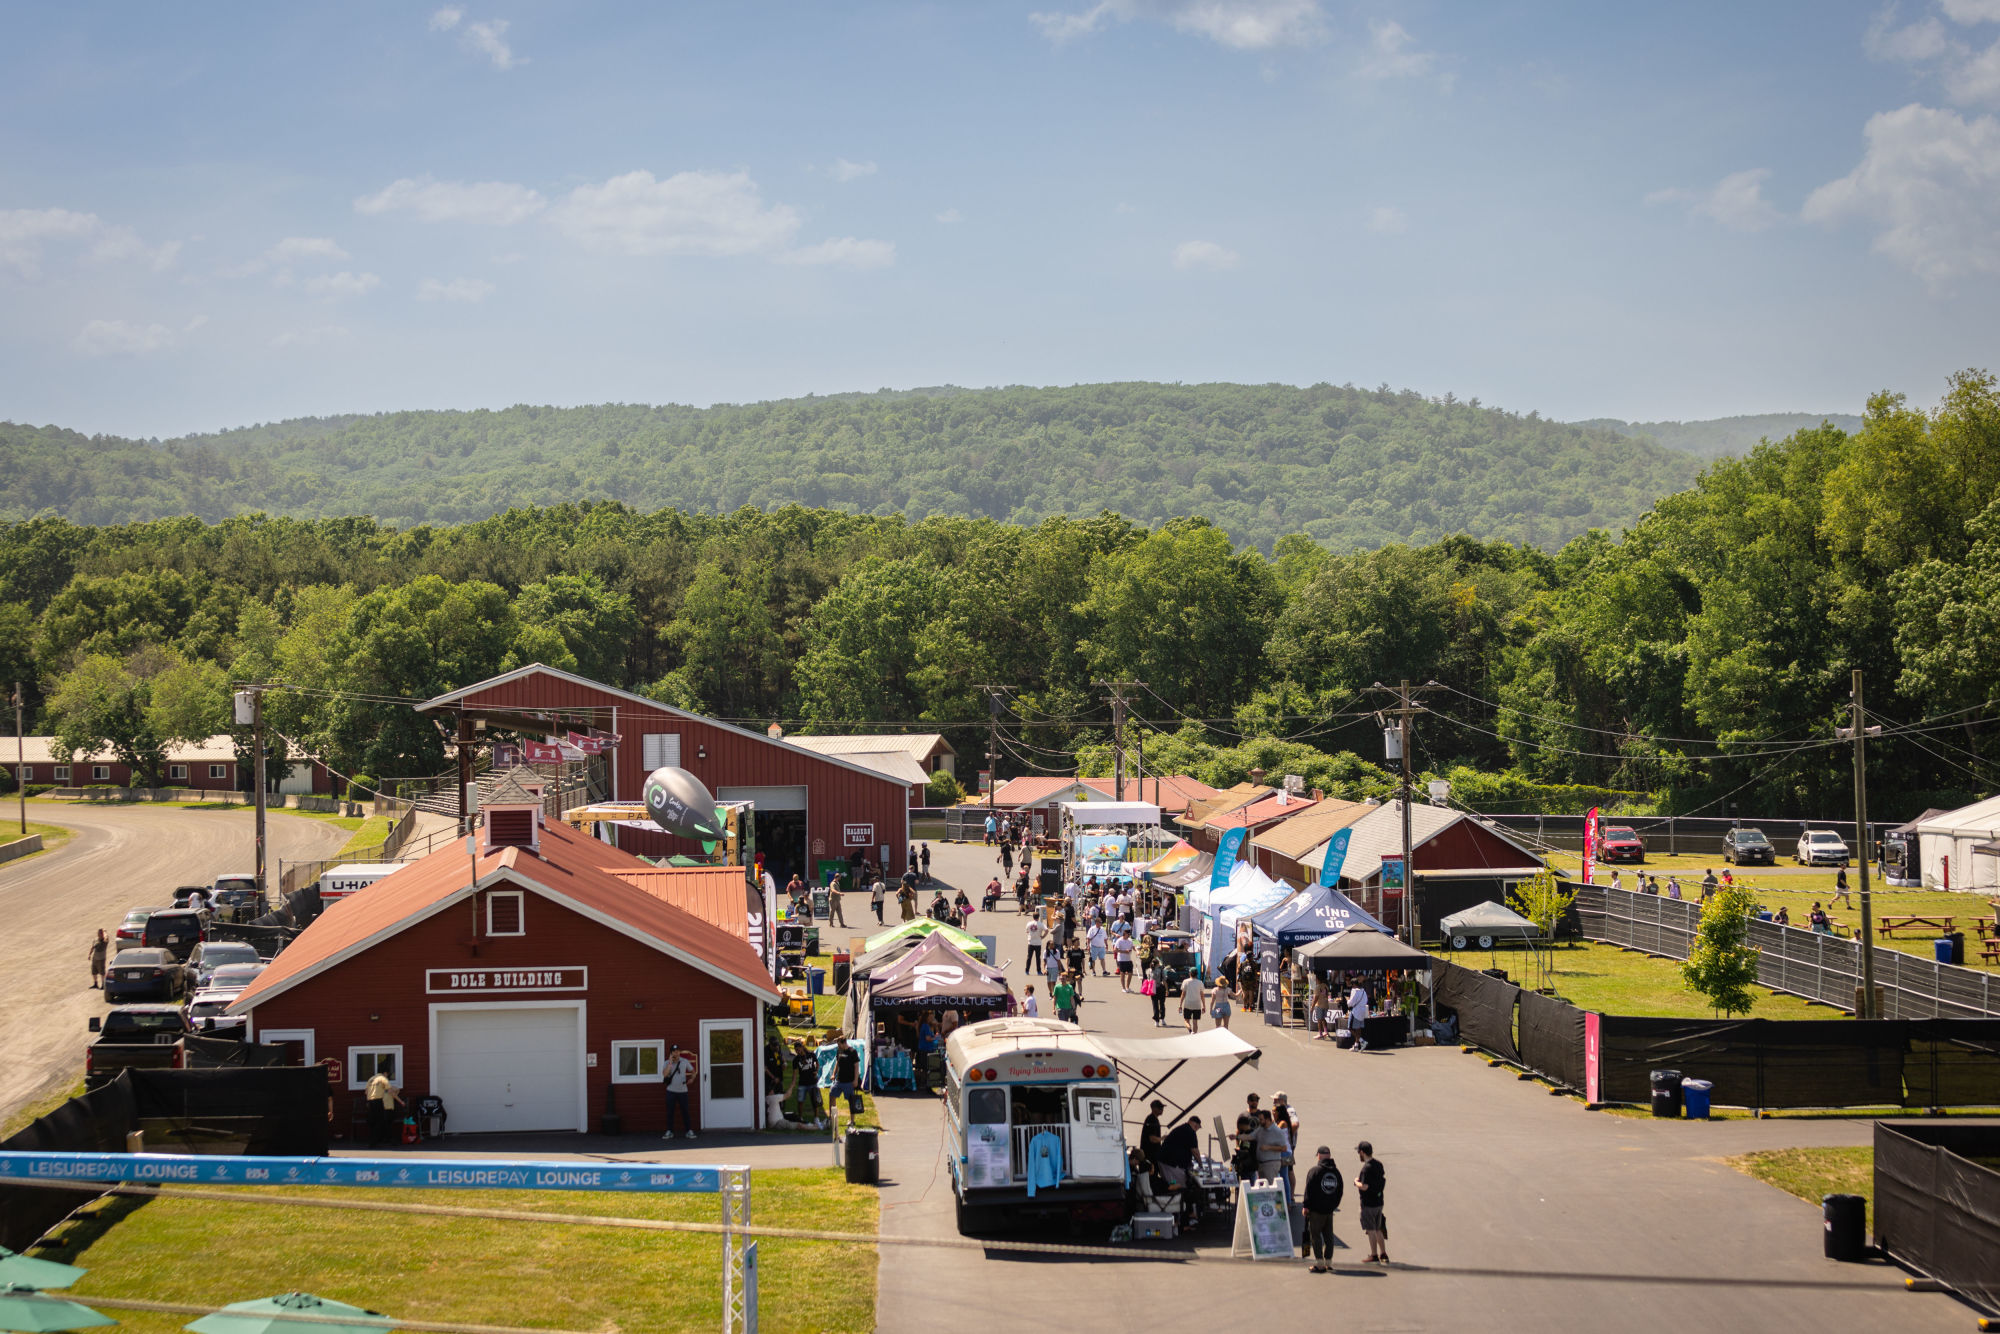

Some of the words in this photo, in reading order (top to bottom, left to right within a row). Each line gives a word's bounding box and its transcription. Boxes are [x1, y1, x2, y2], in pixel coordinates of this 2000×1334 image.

[1315, 905, 1350, 918] KING
[1325, 920, 1345, 928] OG
[451, 974, 486, 988] DOLE
[494, 972, 562, 986] BUILDING
[1262, 968, 1279, 984] KING
[873, 997, 906, 1006] ENJOY
[909, 996, 947, 1006] HIGHER
[1266, 989, 1276, 1002] OG
[28, 1160, 127, 1177] LEISUREPAY
[134, 1164, 198, 1179] LOUNGE
[428, 1169, 528, 1186] LEISUREPAY
[536, 1171, 601, 1187] LOUNGE
